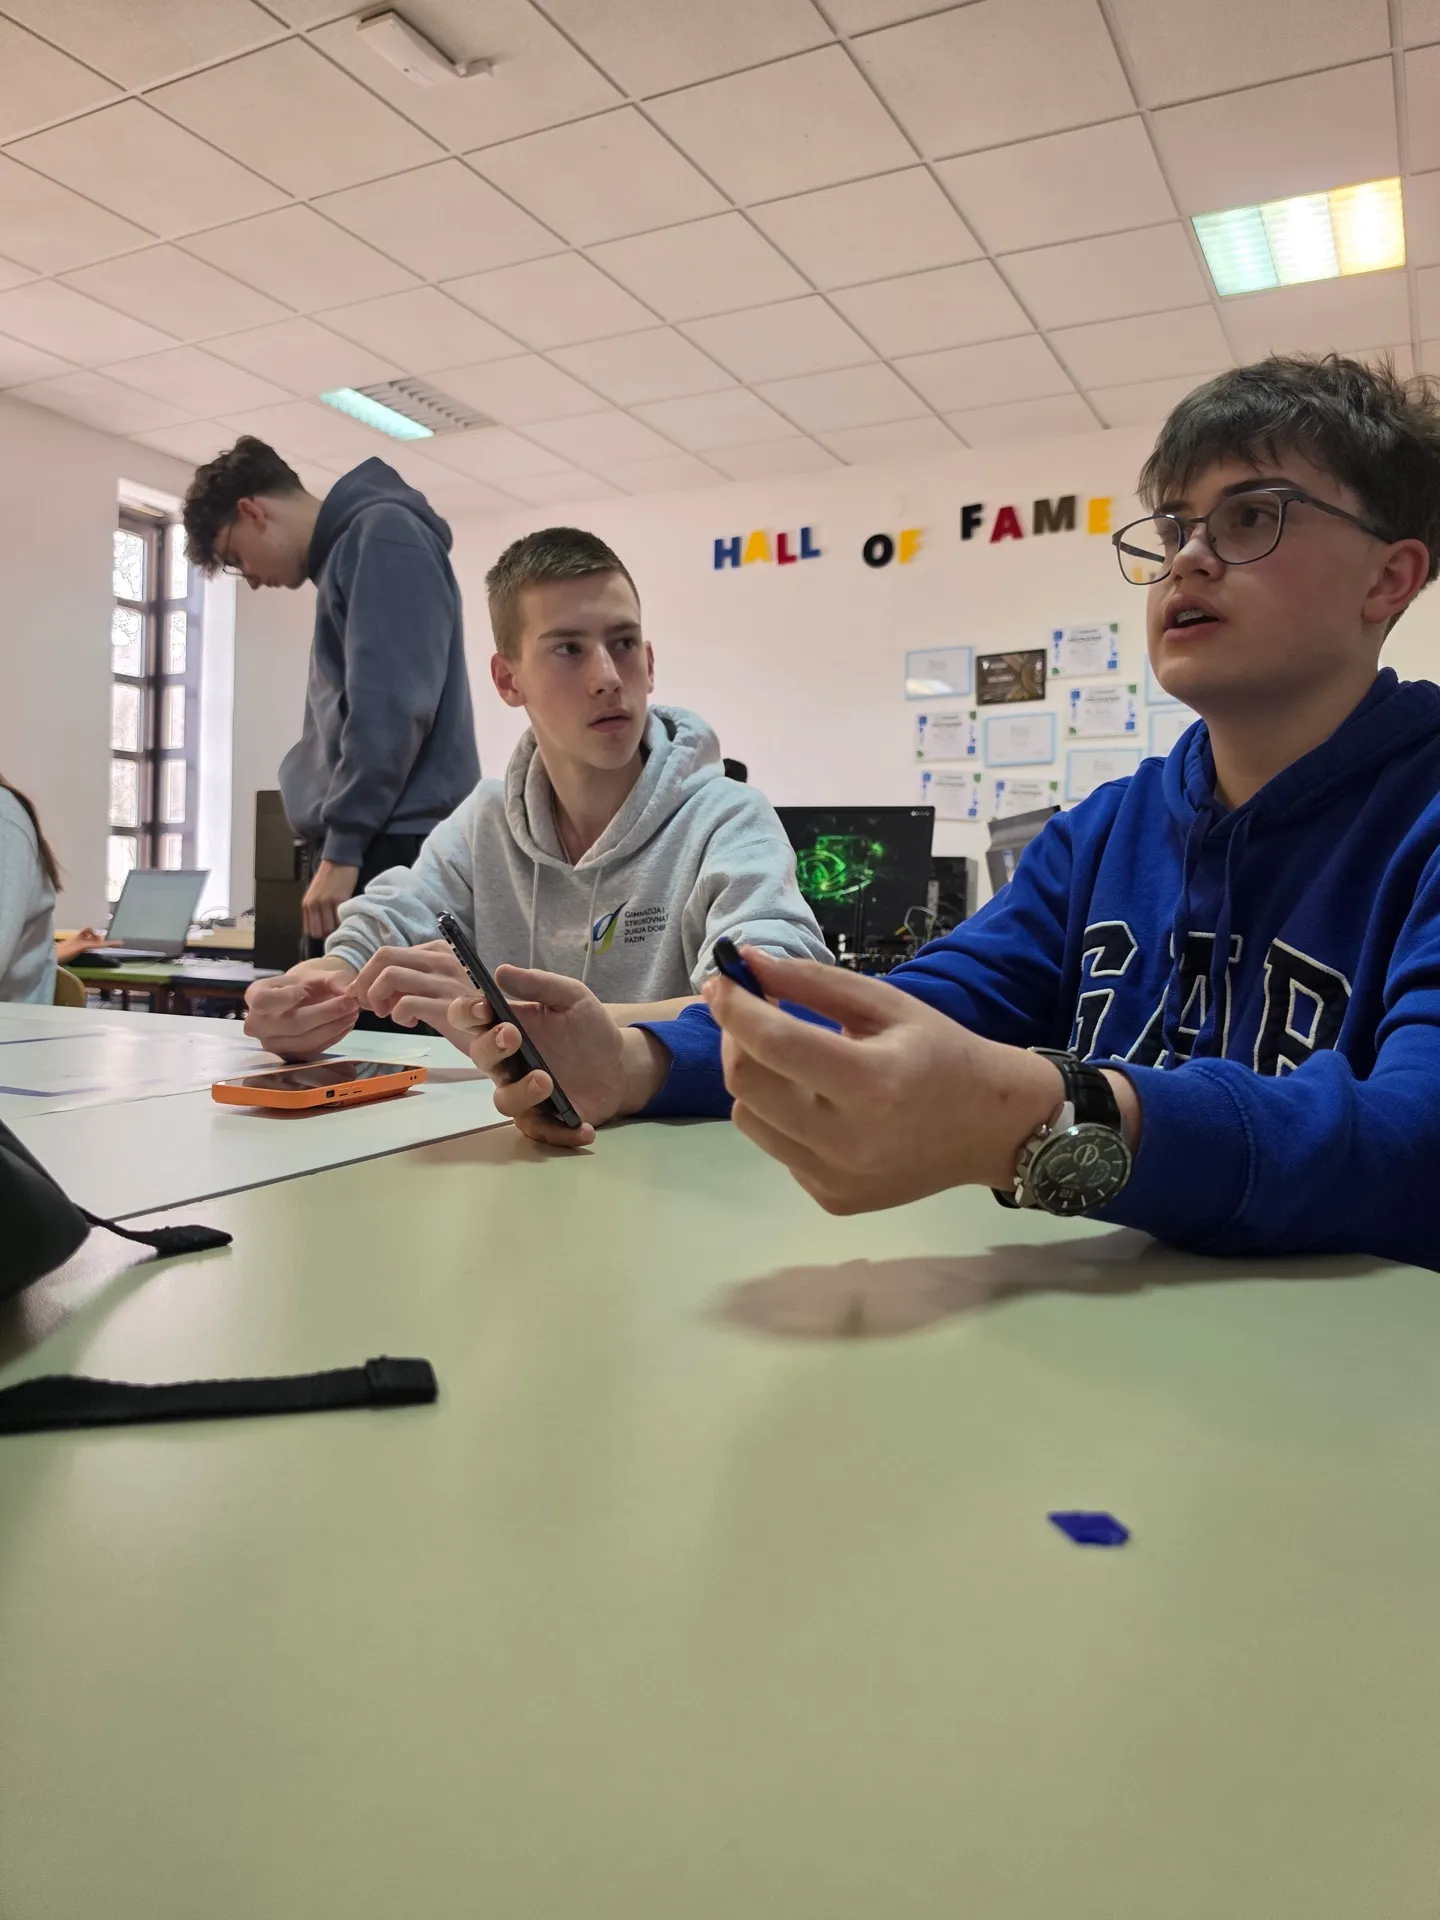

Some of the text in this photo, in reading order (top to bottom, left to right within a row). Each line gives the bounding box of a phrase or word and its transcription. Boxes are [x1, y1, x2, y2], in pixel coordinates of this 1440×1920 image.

[713, 495, 1113, 570] HALL OF FAME
[624, 907, 662, 918] GIMNAZIJA
[624, 916, 666, 926] STRUKOVNA
[624, 927, 646, 936] JURJA
[624, 936, 645, 944] PAZIN
